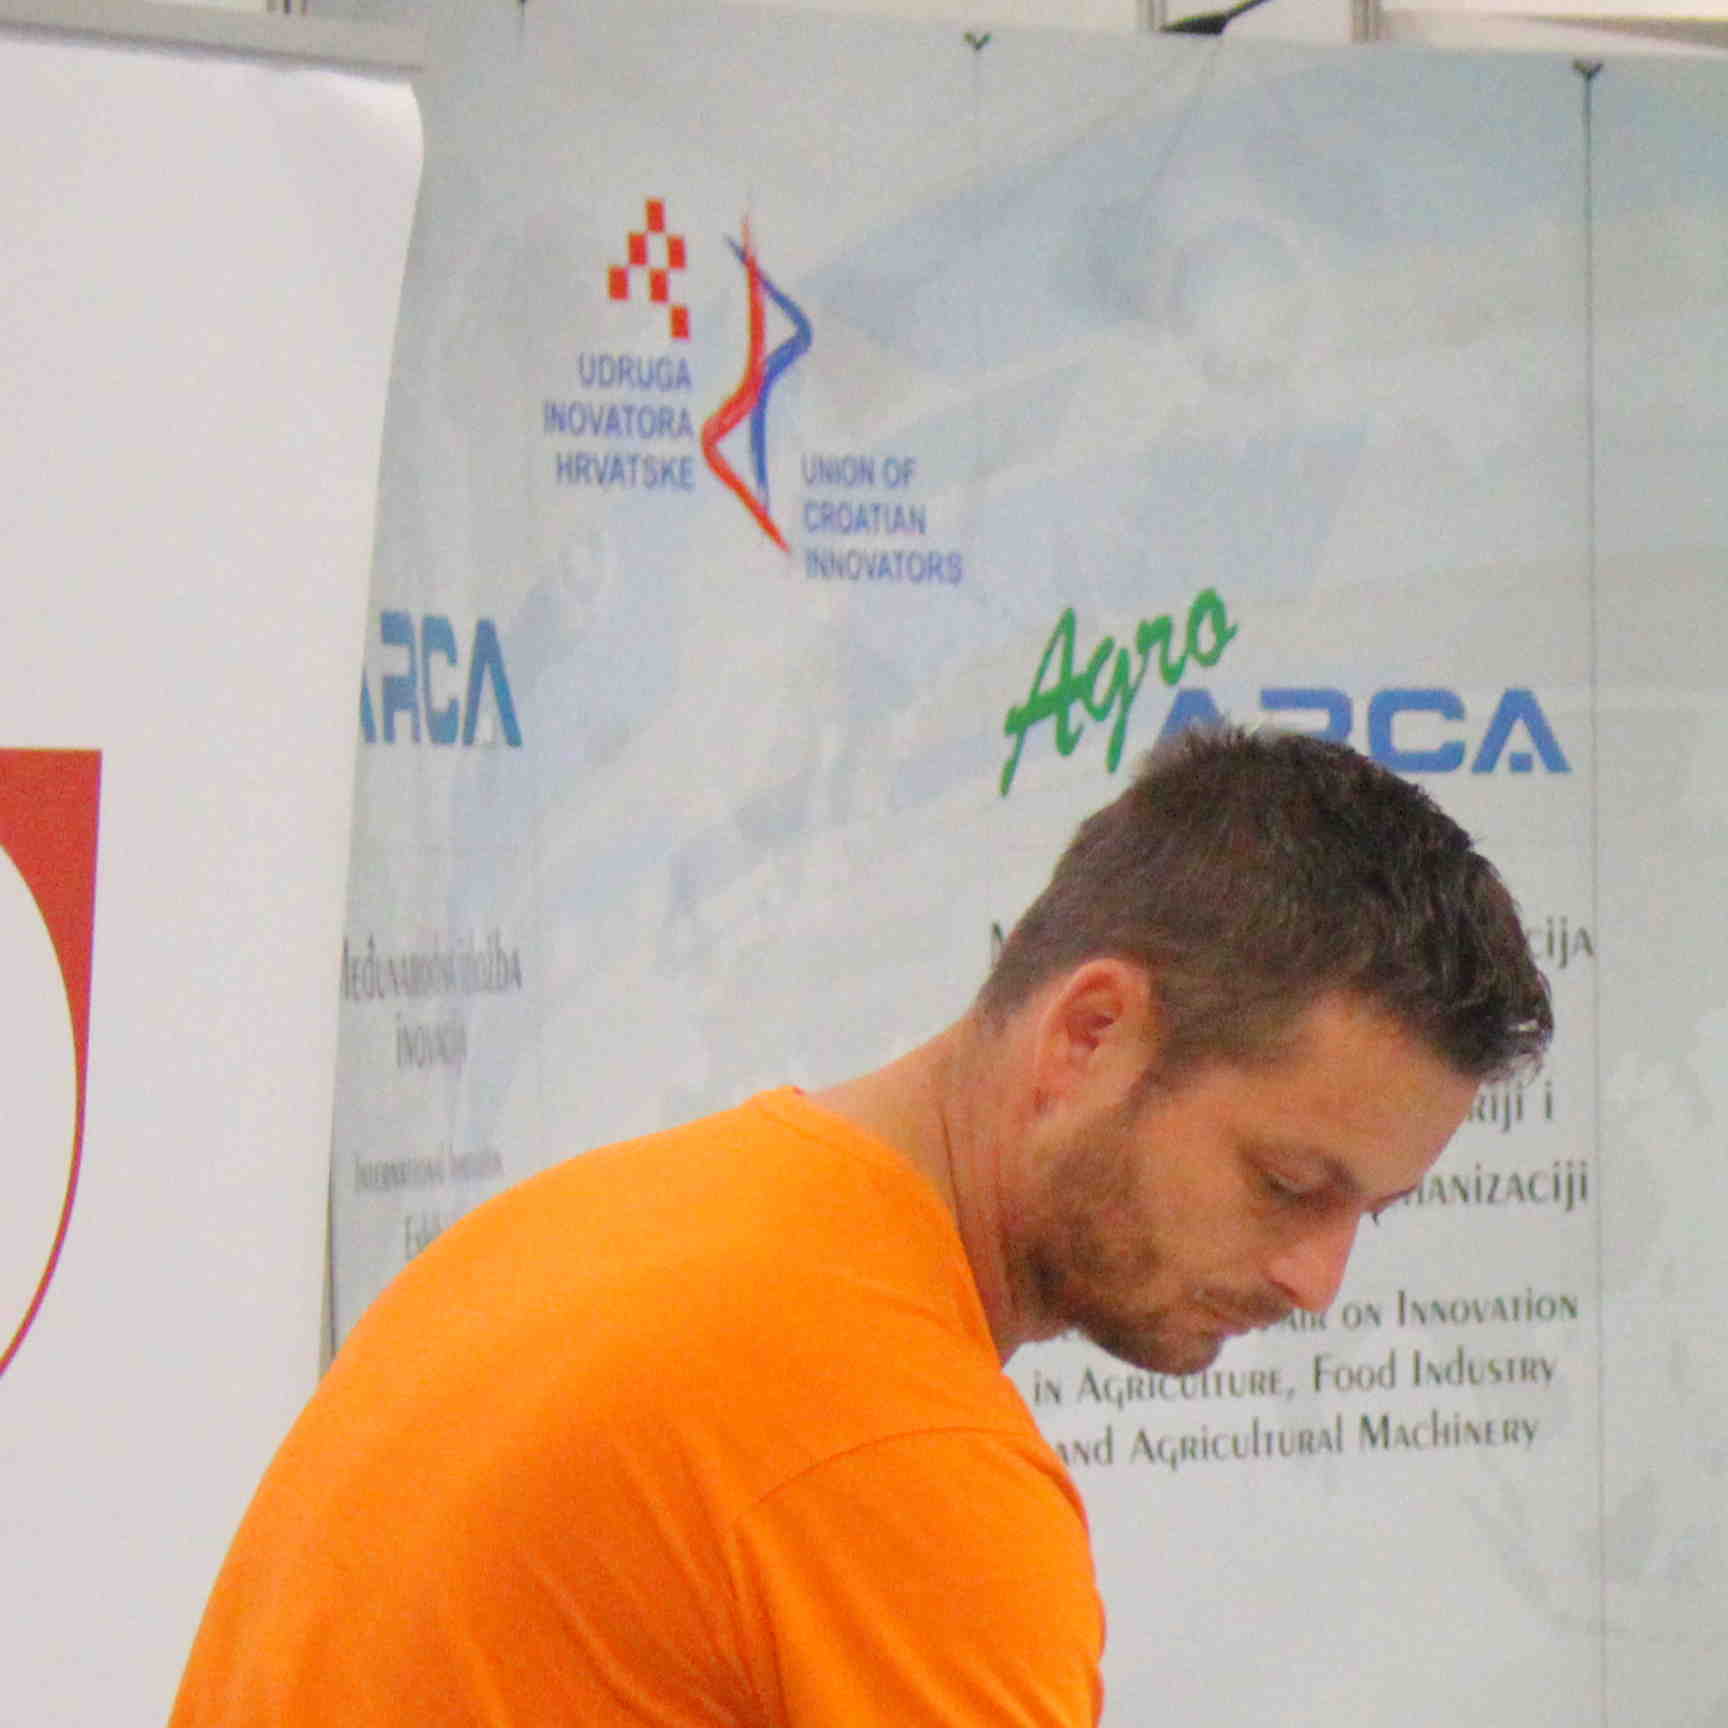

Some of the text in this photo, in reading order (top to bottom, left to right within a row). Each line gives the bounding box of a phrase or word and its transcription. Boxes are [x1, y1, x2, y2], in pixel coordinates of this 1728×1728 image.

[578, 352, 692, 389] UDRUGA
[543, 400, 694, 440] INOVATORA
[556, 452, 696, 492] HRVATSKE
[801, 453, 917, 489] UNION OF
[804, 500, 928, 535] CROATIAN
[804, 548, 963, 585] INNOVATORS
[360, 611, 523, 747] RCA
[1000, 588, 1239, 798] Agro
[1312, 1347, 1397, 1393] Food
